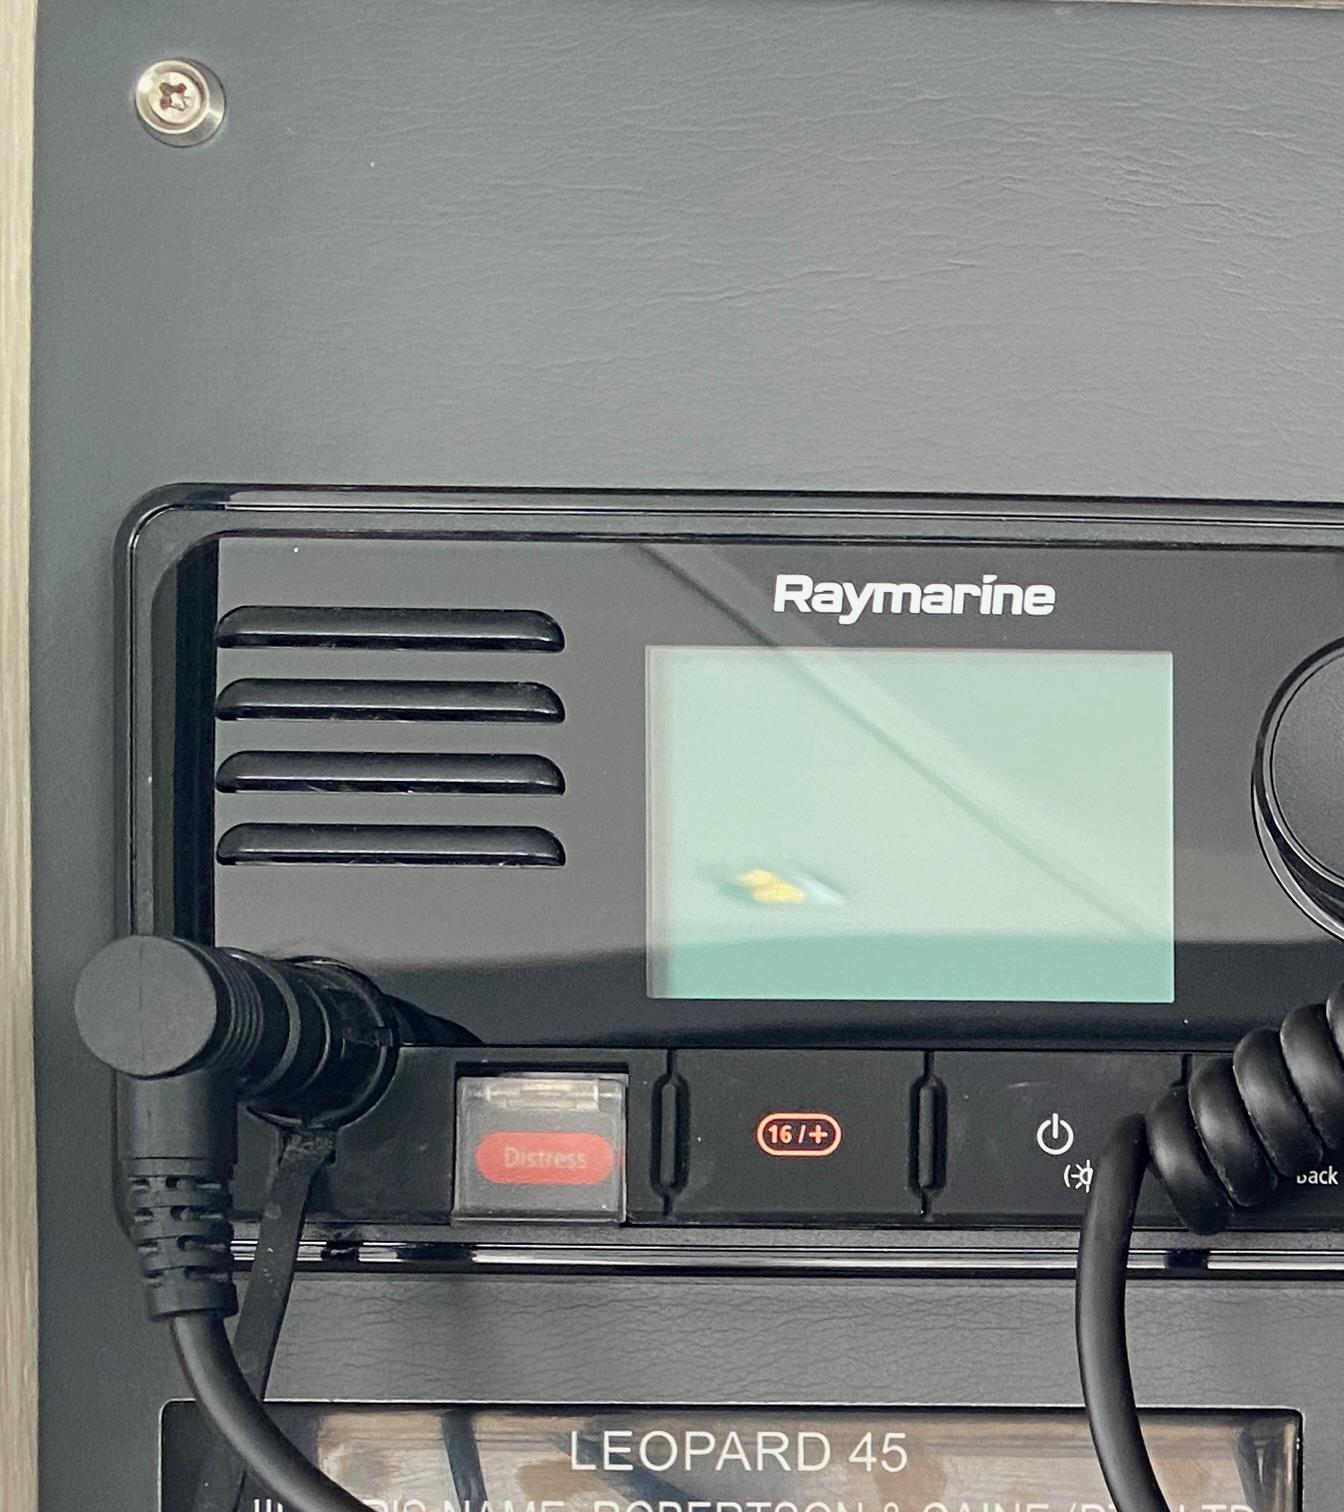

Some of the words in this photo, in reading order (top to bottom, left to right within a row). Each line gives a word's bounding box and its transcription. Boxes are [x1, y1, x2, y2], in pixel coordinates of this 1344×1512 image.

[773, 574, 1056, 625] Raymarine
[504, 1147, 588, 1169] Distress
[570, 1430, 831, 1472] LEOPARD
[848, 1432, 908, 1472] 45
